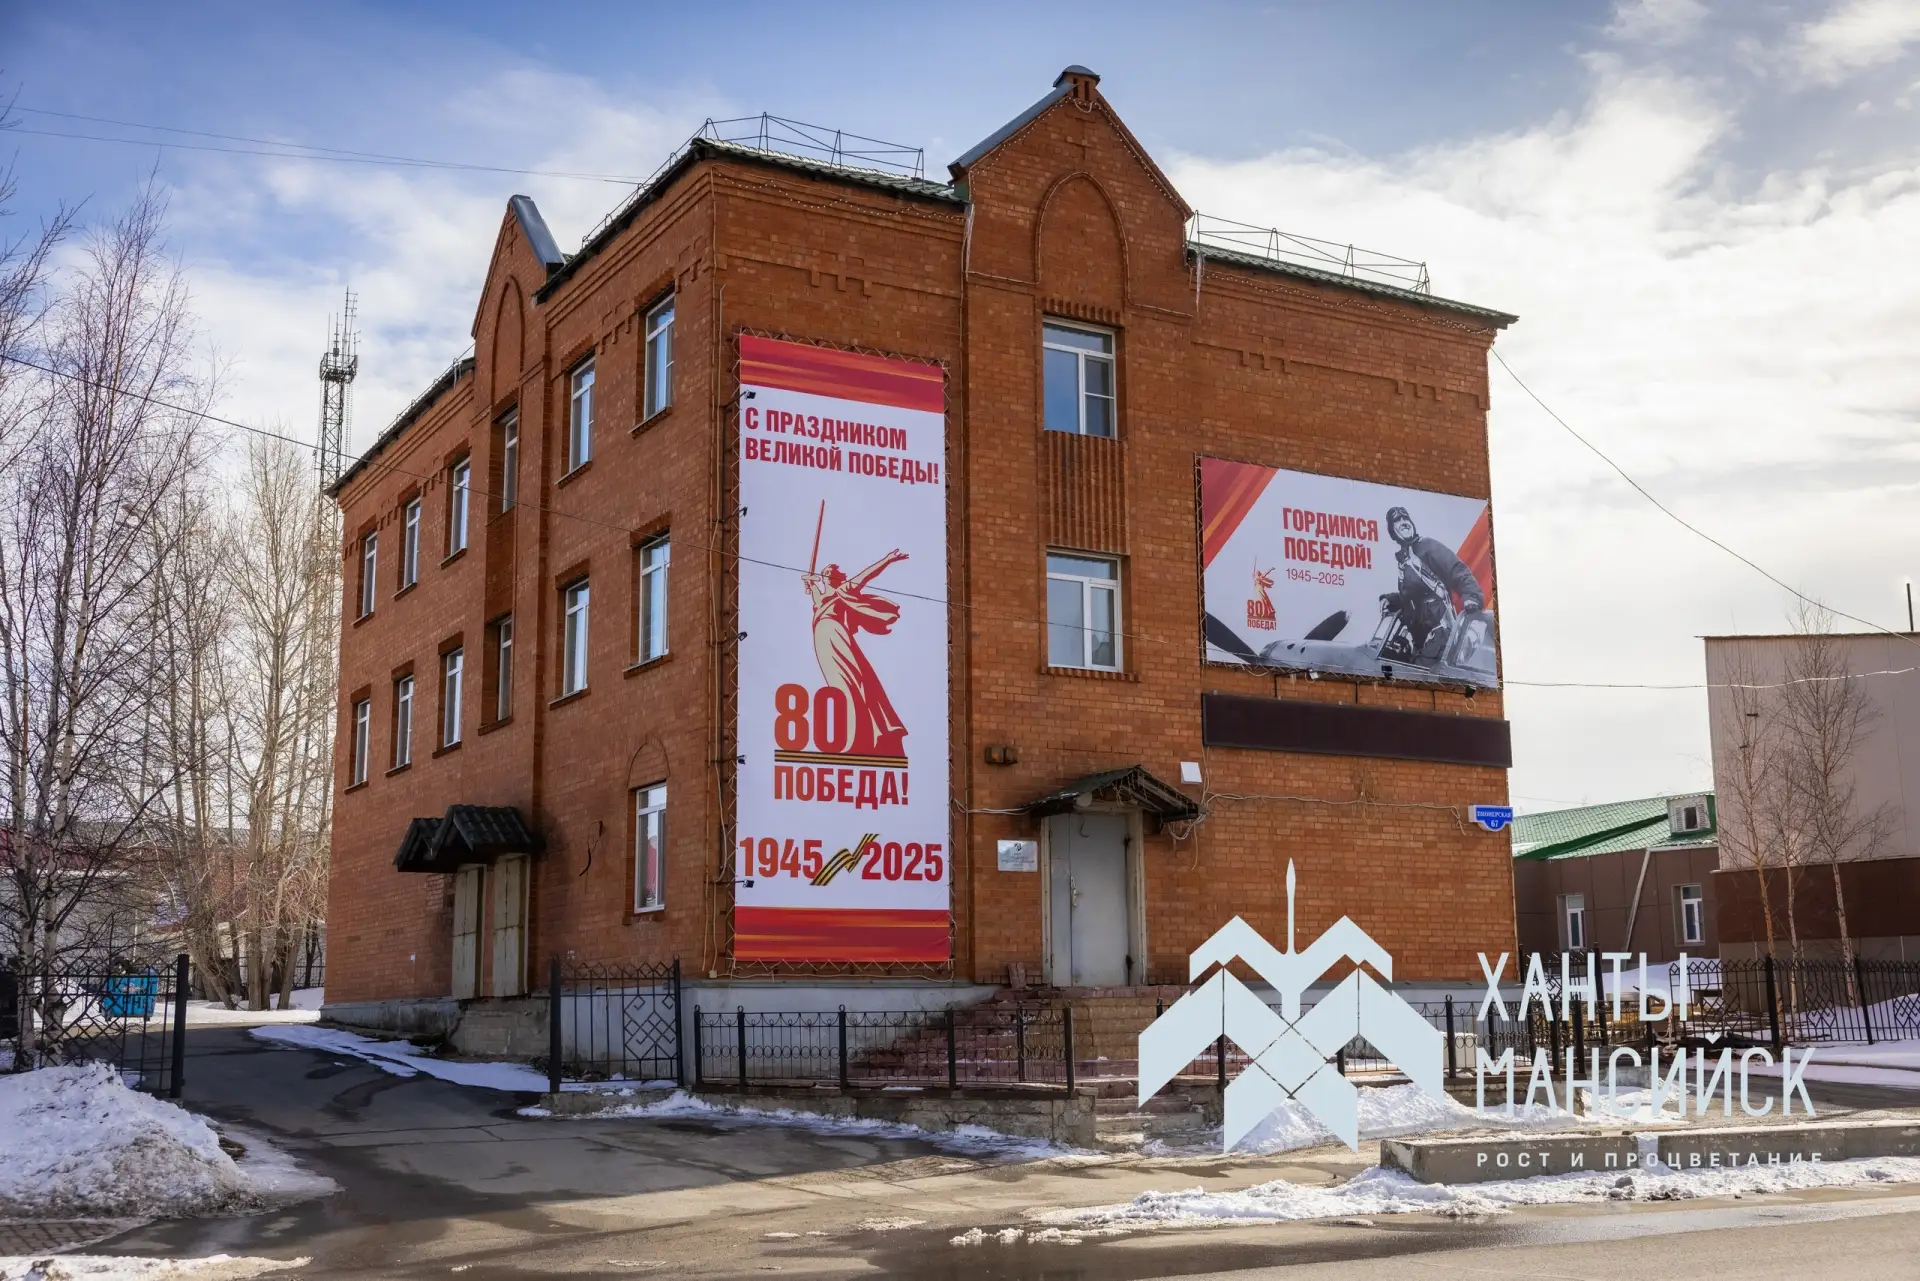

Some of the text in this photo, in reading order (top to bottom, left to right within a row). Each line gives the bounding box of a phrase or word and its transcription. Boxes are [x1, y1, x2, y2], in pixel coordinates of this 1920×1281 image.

[745, 407, 907, 450] С ПРАЗДНИКОМ
[745, 437, 939, 484] ВЕЛИКОЙ ПОБЕДЫ!
[1282, 507, 1378, 541] ГОРДИМСЯ
[1284, 536, 1371, 569] ПОБЕДОЙ!
[1247, 599, 1263, 617] 80
[1247, 619, 1277, 631] ПОБЕДА!
[774, 683, 848, 752] 80
[774, 766, 908, 810] ПОБЕДА!
[739, 837, 943, 882] 1945 2025
